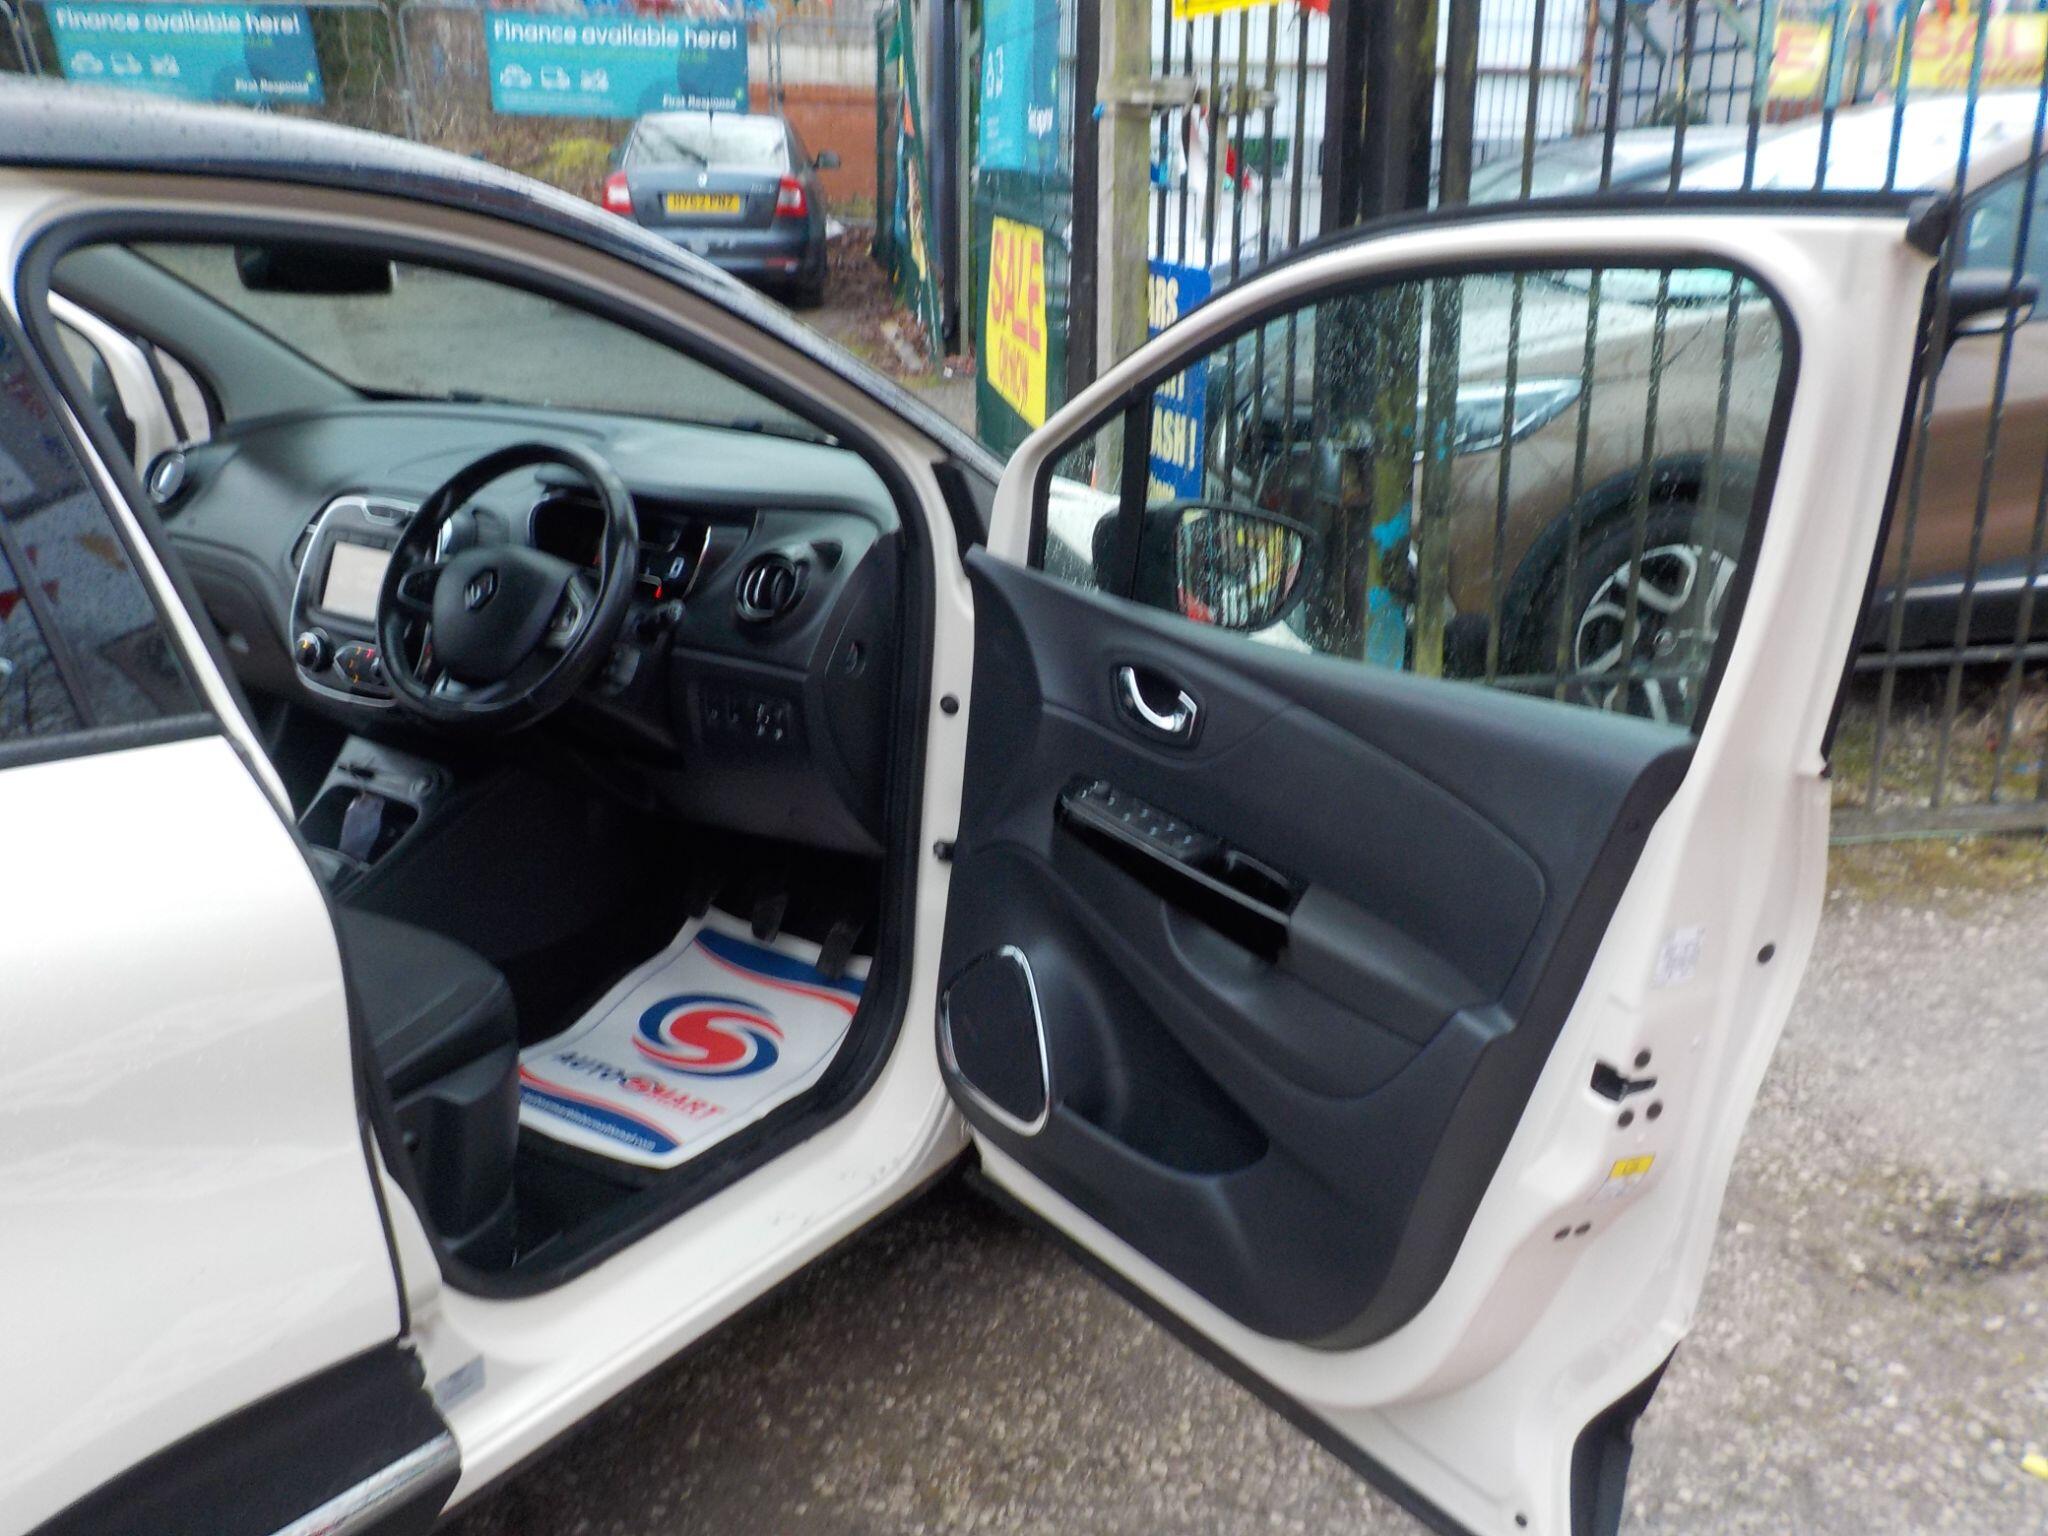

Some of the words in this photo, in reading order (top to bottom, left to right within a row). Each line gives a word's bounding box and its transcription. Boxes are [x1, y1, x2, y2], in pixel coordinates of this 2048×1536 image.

[56, 8, 140, 32] Finance
[144, 10, 241, 34] available
[494, 18, 577, 45] Finance
[581, 23, 680, 47] available
[684, 27, 738, 50] here!
[991, 228, 1042, 353] SALE
[1148, 274, 1180, 331] ARS
[1150, 404, 1198, 472] ASH!
